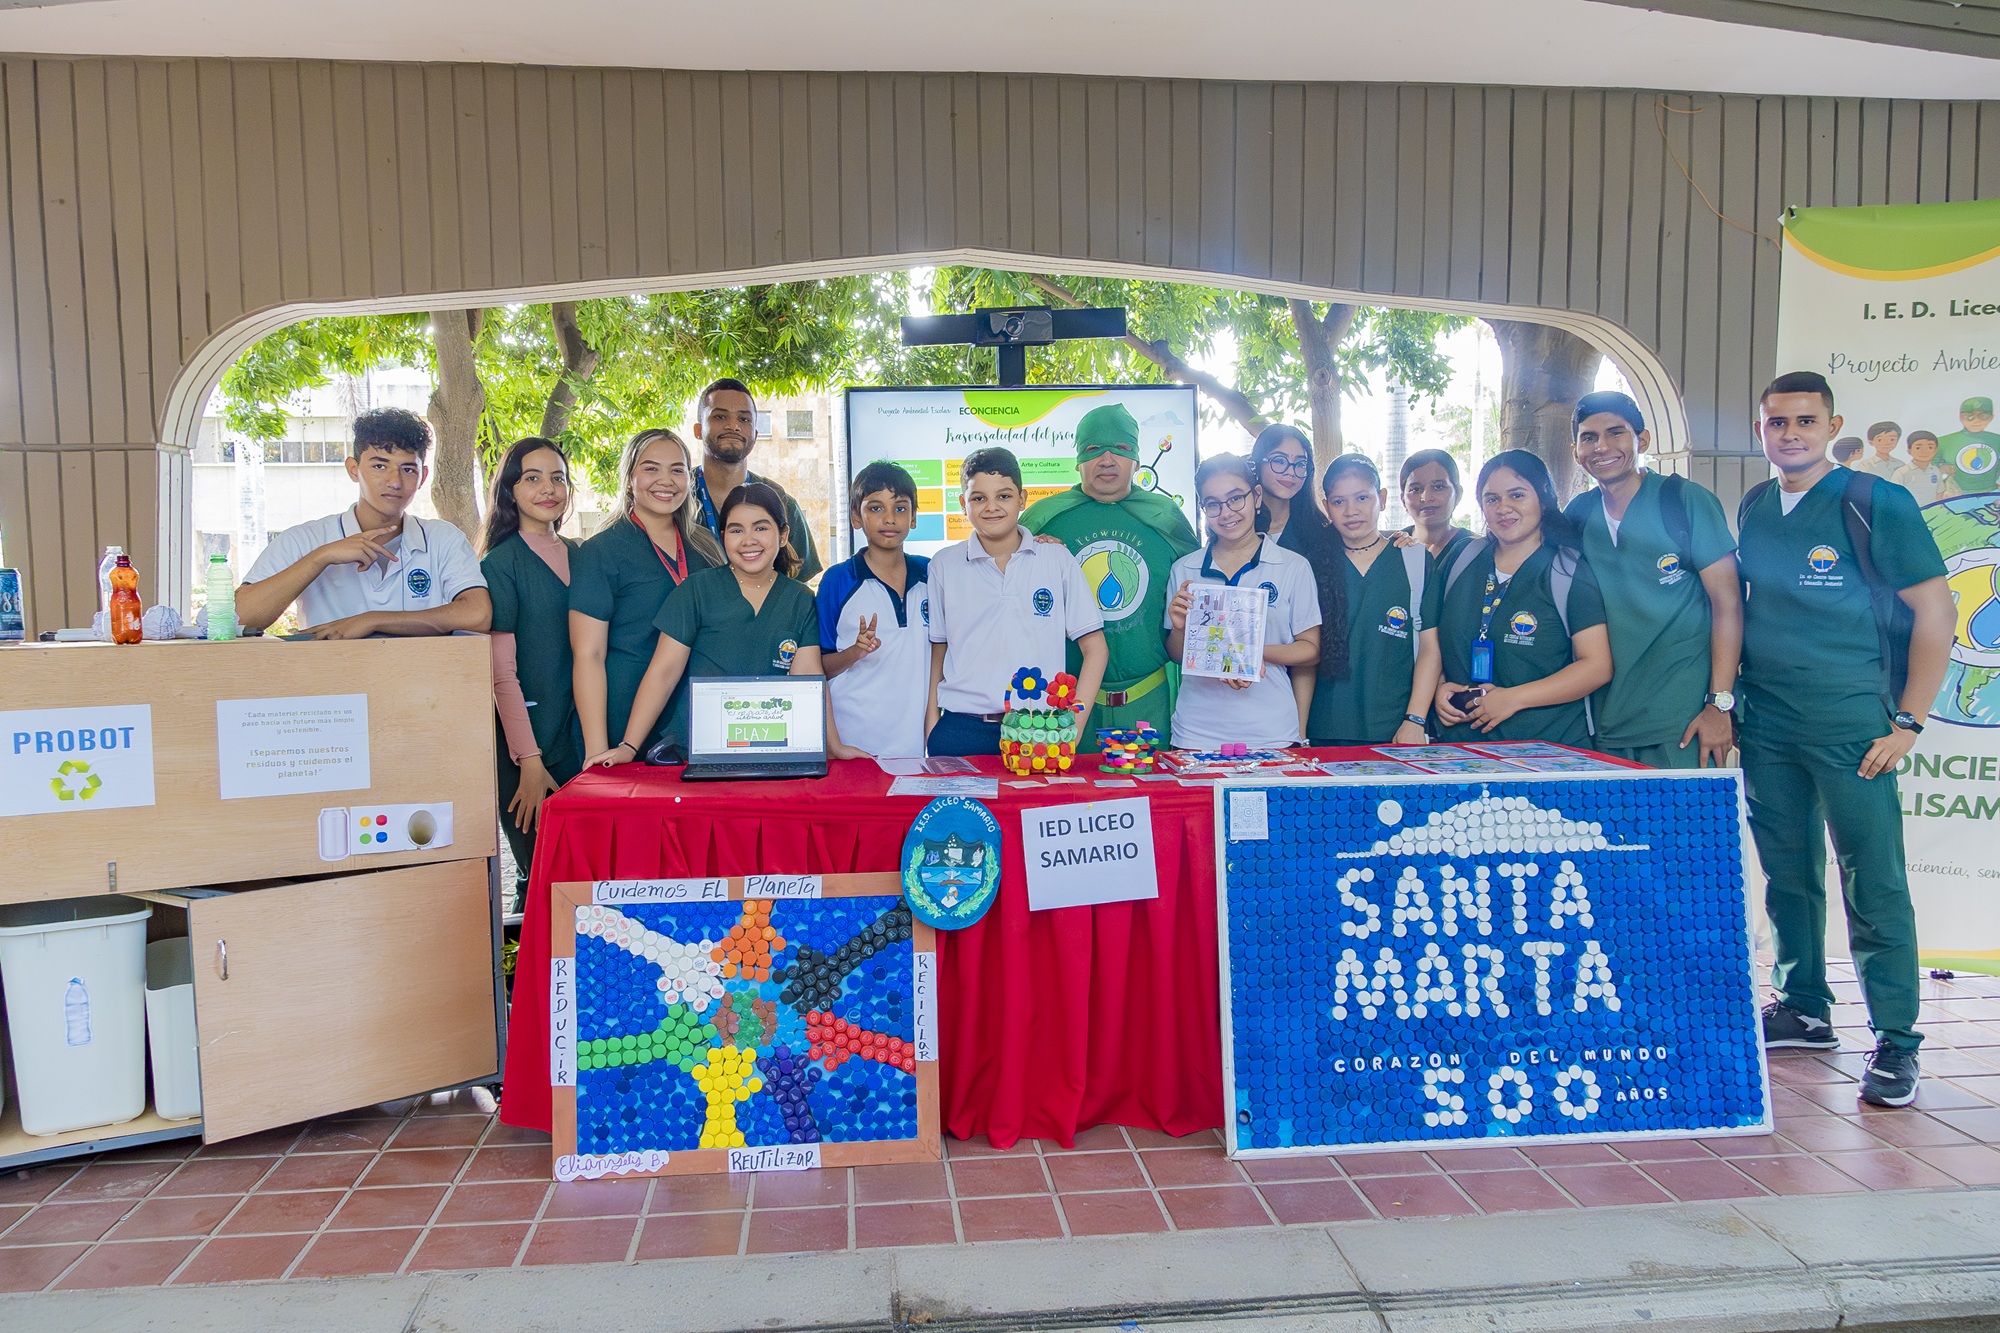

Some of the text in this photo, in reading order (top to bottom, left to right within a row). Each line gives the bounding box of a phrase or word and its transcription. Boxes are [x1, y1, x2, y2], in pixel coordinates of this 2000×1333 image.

[1863, 303, 1877, 320] I.
[1884, 302, 1904, 319] E.
[1911, 301, 1936, 318] D.
[1828, 352, 1919, 382] Proyecto
[877, 406, 1020, 417] Proyecto Ambiental Escolar ECONCIENCIA
[1031, 427, 1049, 441] del
[13, 727, 135, 755] PROBOT
[735, 727, 769, 741] PLAY
[246, 760, 287, 768] residuos
[290, 760, 296, 768] y
[298, 757, 342, 766] cuidemos
[309, 745, 349, 754] nuestros
[1897, 753, 2000, 781] ONCIE
[933, 796, 959, 819] LICEO
[962, 801, 996, 833] SAMARIO
[1039, 812, 1135, 838] IED LICEO
[1040, 842, 1139, 868] SAMARIO
[596, 881, 688, 902] Cuidemos
[702, 879, 727, 899] EL
[1335, 860, 1594, 940] SANTA
[1331, 940, 1622, 1021] MARTA
[1334, 1046, 1668, 1074] CORAZON DEL MUNDO
[1423, 1064, 1602, 1126] 500
[1616, 1086, 1668, 1103] AÑOS
